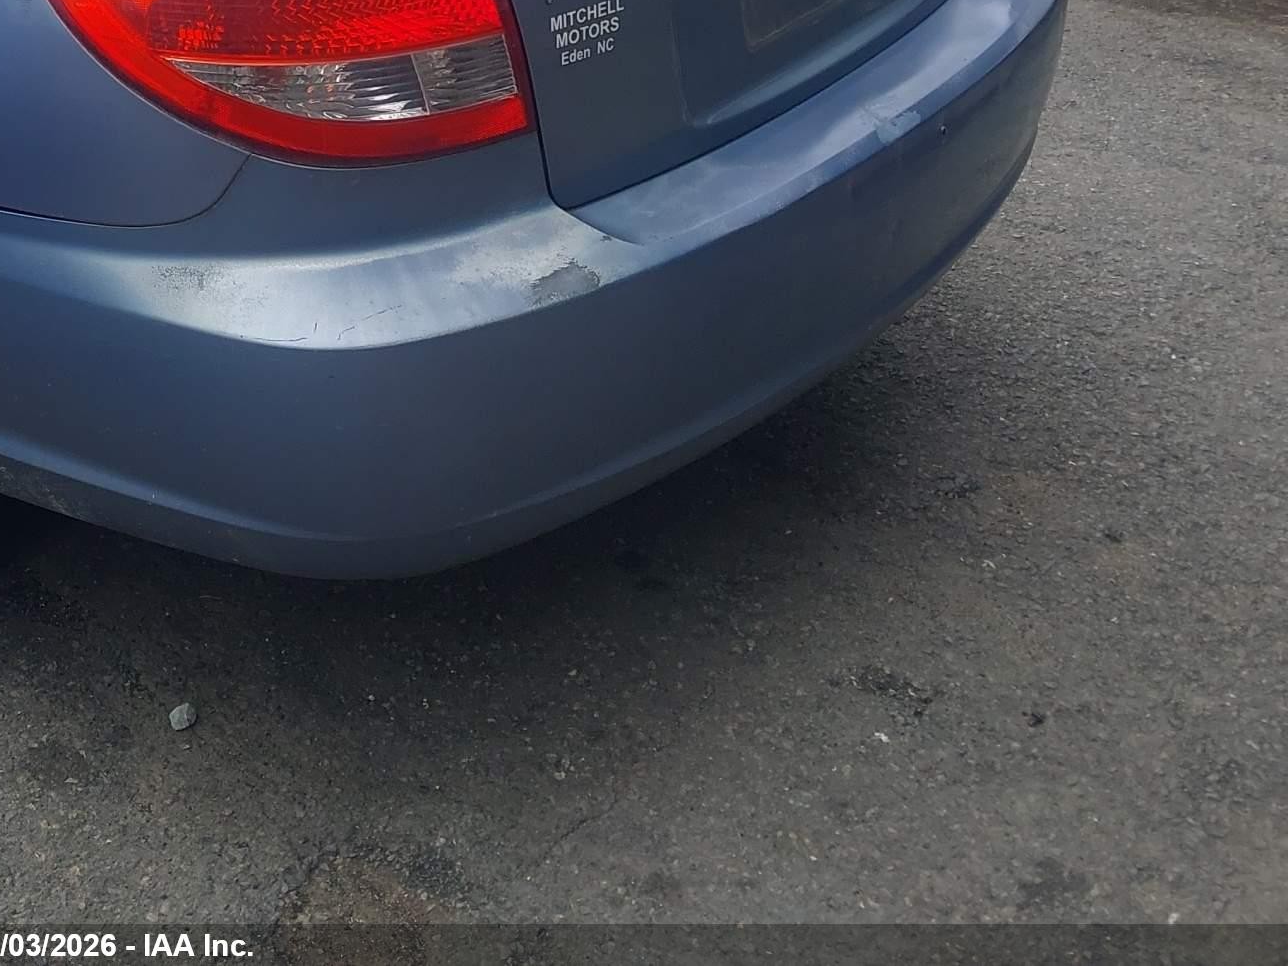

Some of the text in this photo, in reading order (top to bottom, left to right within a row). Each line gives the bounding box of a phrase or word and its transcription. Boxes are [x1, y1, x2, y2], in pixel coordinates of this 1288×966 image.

[555, 16, 620, 49] MOTORS
[561, 37, 615, 66] Eden NC
